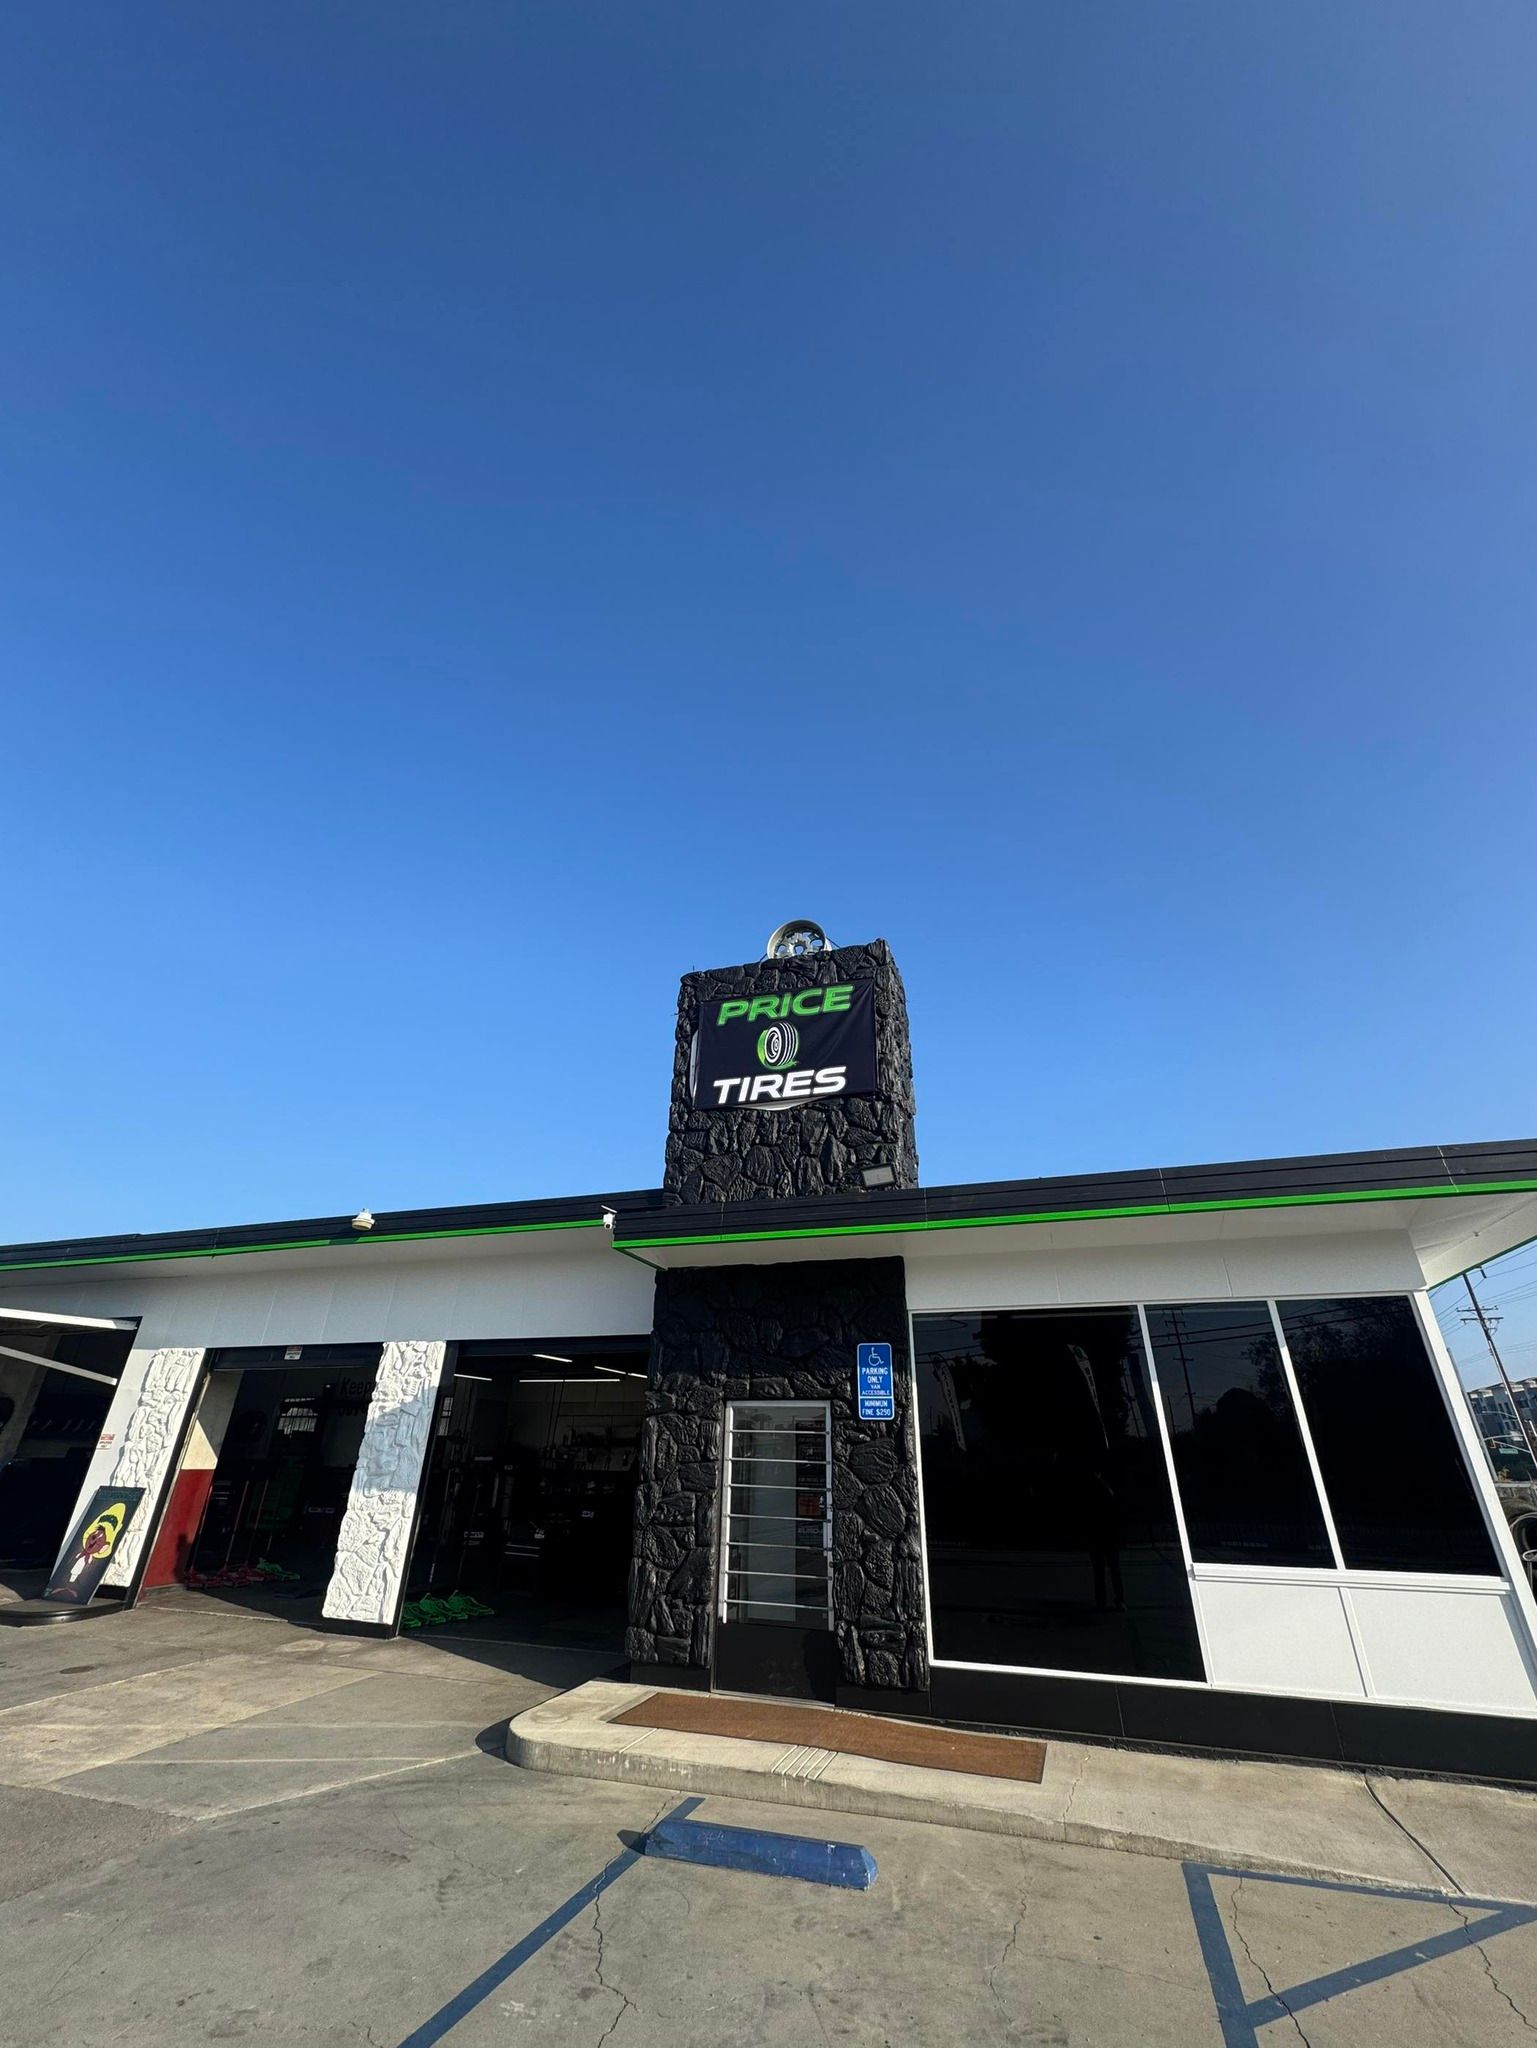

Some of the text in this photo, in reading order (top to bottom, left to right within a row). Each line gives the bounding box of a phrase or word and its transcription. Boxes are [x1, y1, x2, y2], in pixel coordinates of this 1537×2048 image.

[717, 984, 854, 1025] PRICE
[713, 1066, 847, 1104] TIRES
[862, 1367, 888, 1375] PARKING
[864, 1399, 888, 1407] MINIMUM
[862, 1408, 891, 1416] FINE $250
